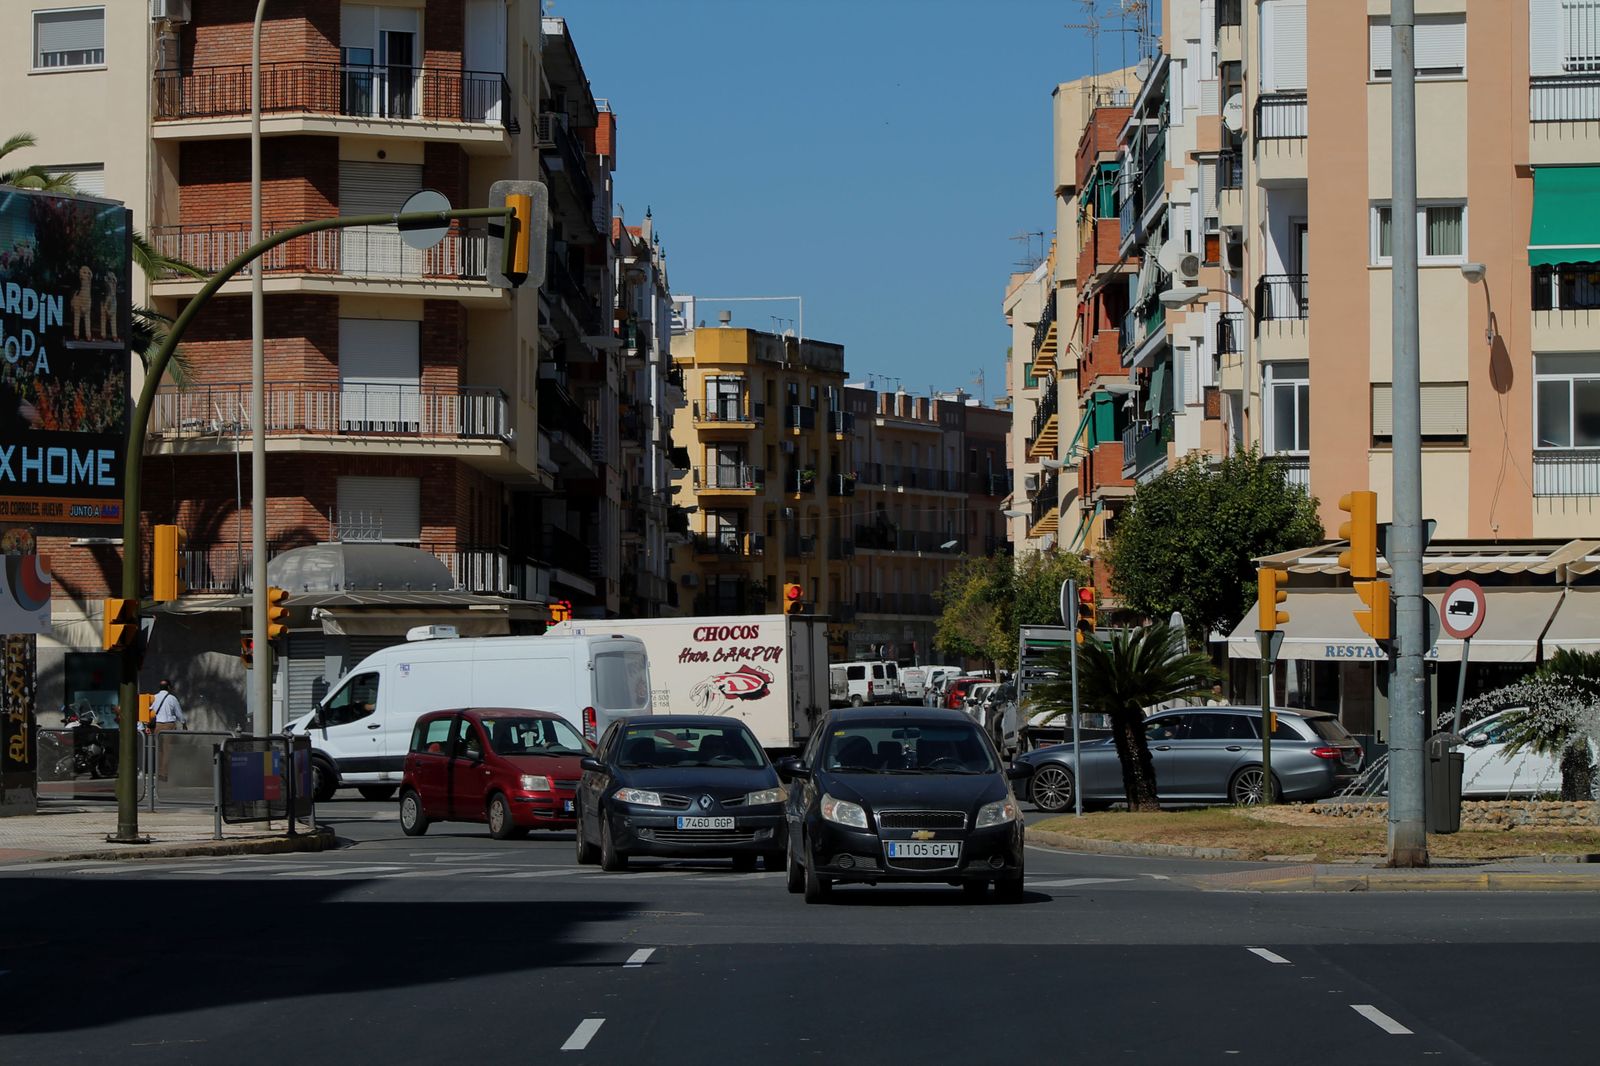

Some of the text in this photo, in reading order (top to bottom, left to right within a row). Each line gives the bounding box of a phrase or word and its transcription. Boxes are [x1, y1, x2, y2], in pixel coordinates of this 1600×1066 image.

[0, 319, 51, 376] ODA
[70, 504, 93, 517] JUNTO
[94, 505, 100, 517] A
[693, 624, 760, 642] CHOCOS
[1325, 645, 1439, 658] RESTAUE
[685, 817, 732, 828] 7460 GGP
[898, 844, 956, 856] 1105 GFV
